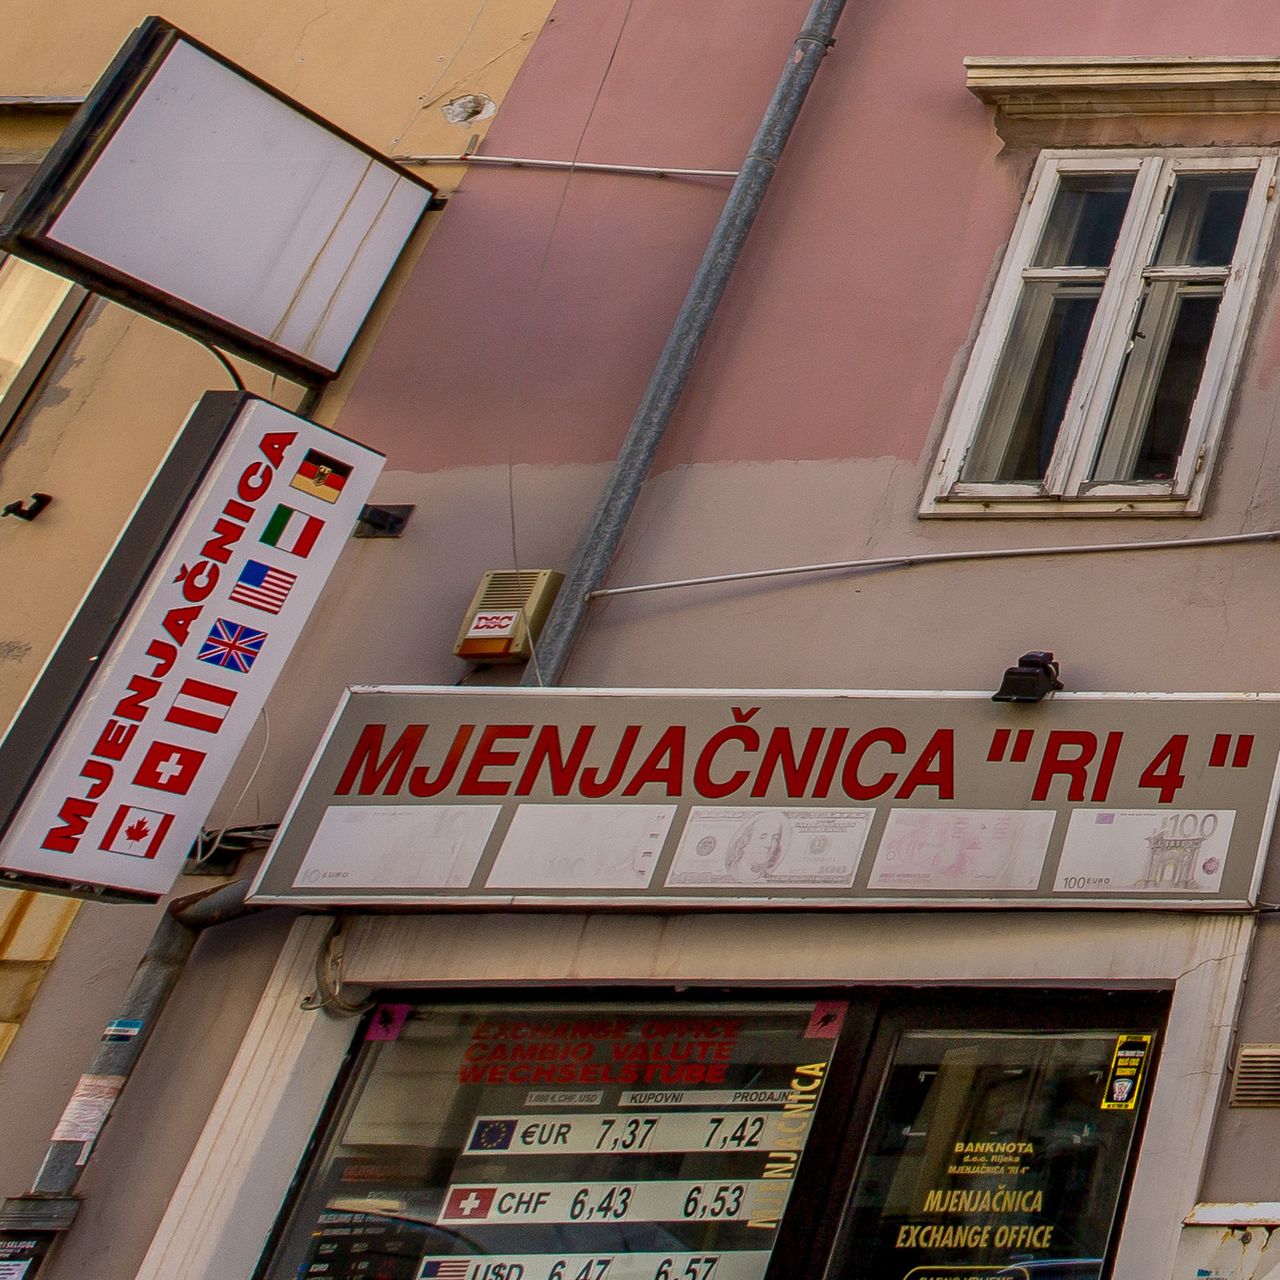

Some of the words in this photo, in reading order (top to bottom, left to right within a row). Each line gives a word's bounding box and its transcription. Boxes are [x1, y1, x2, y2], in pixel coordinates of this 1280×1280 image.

[40, 431, 298, 854] MJENJAČNICA
[333, 707, 955, 801] MJENJAČNICA
[1063, 876, 1086, 889] 100
[1086, 877, 1111, 885] EURO
[473, 1020, 631, 1041] EXCHANGE
[463, 1042, 596, 1062] CAMBIO
[611, 1041, 735, 1062] VALUTE
[458, 1063, 727, 1084] WECHSELSTUBE
[630, 1091, 684, 1104] KUPOVNI
[596, 1117, 658, 1151] 7,37
[704, 1116, 765, 1150] 7,42
[954, 1142, 1034, 1154] BANKNOTA
[497, 1191, 551, 1214] CHF
[570, 1186, 632, 1220] 6,43
[683, 1186, 744, 1219] 6,53
[923, 1184, 1043, 1212] MJENJAČNICA
[895, 1225, 992, 1248] EXCHANGE
[994, 1225, 1055, 1248] OFFICE
